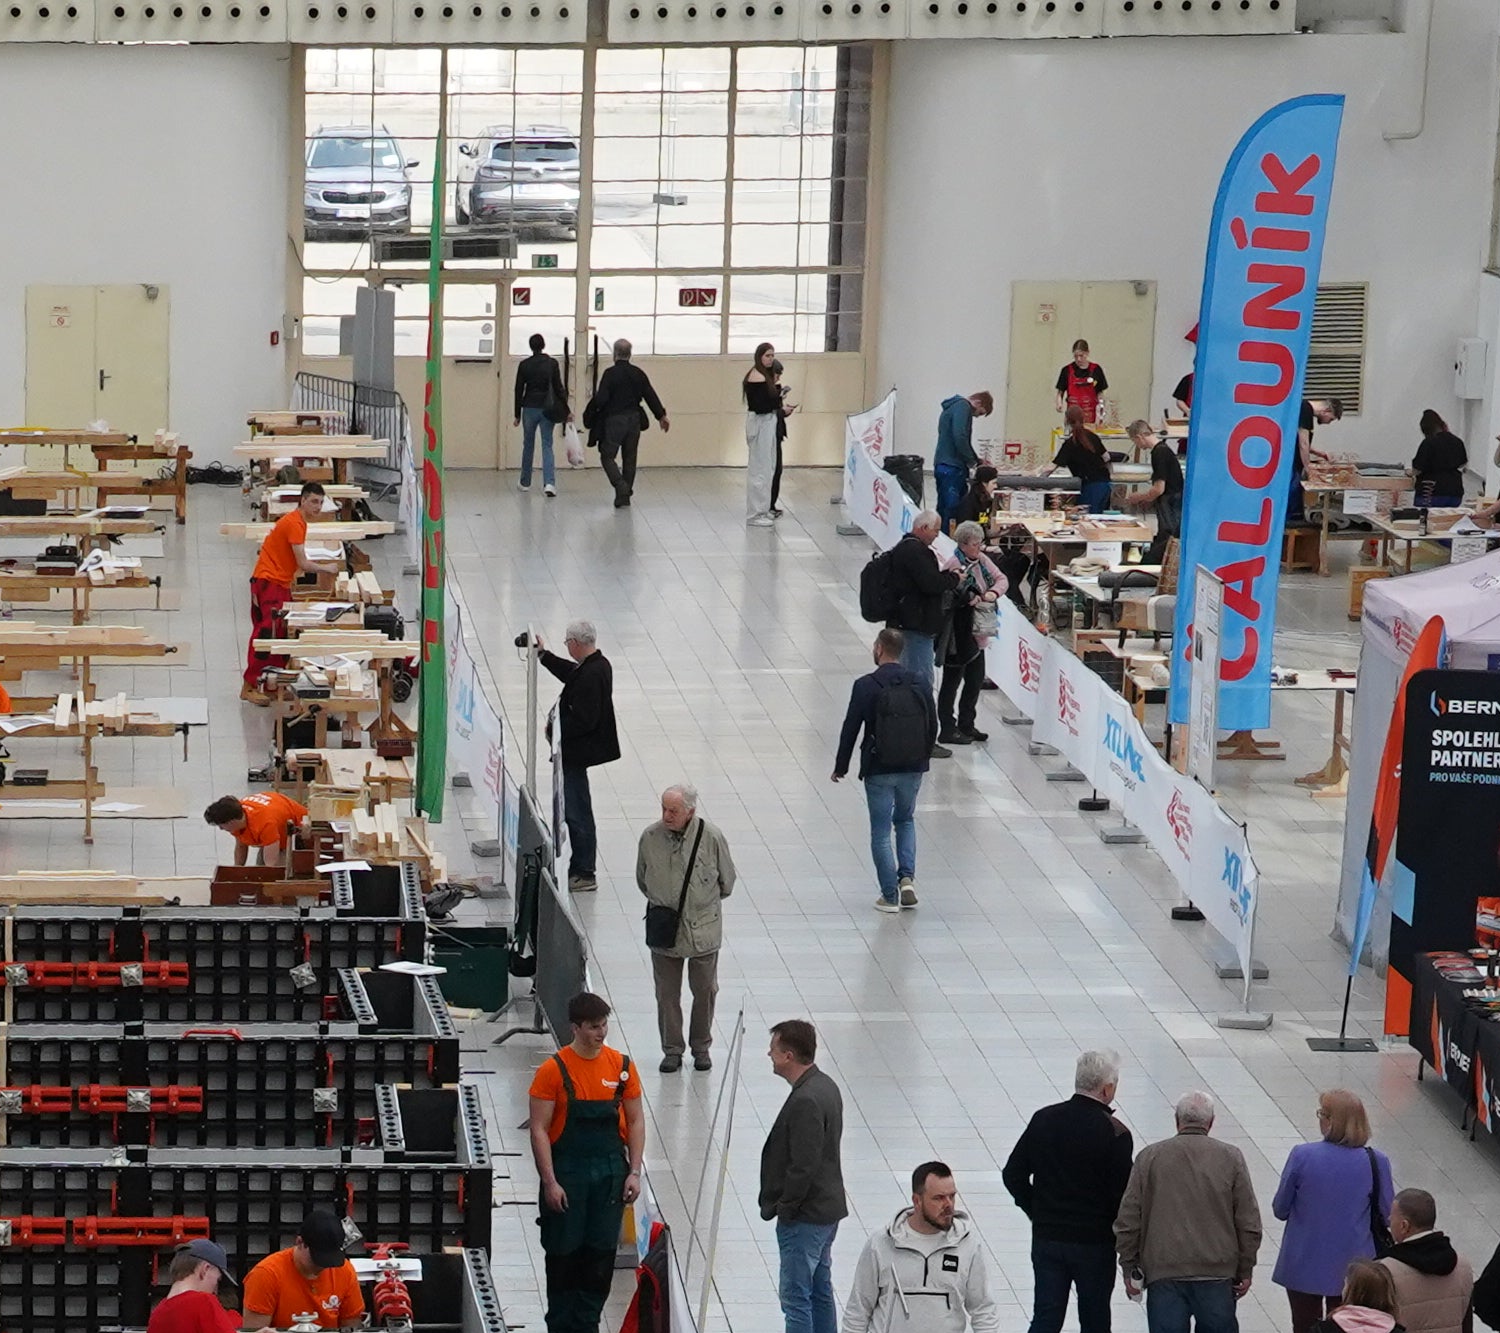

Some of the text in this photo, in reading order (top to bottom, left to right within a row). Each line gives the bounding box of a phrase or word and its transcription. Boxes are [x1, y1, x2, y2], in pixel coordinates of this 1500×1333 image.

[1183, 150, 1323, 682] ČALOUNÍK
[1428, 771, 1450, 783] PRO
[1448, 770, 1473, 784] VAŠE
